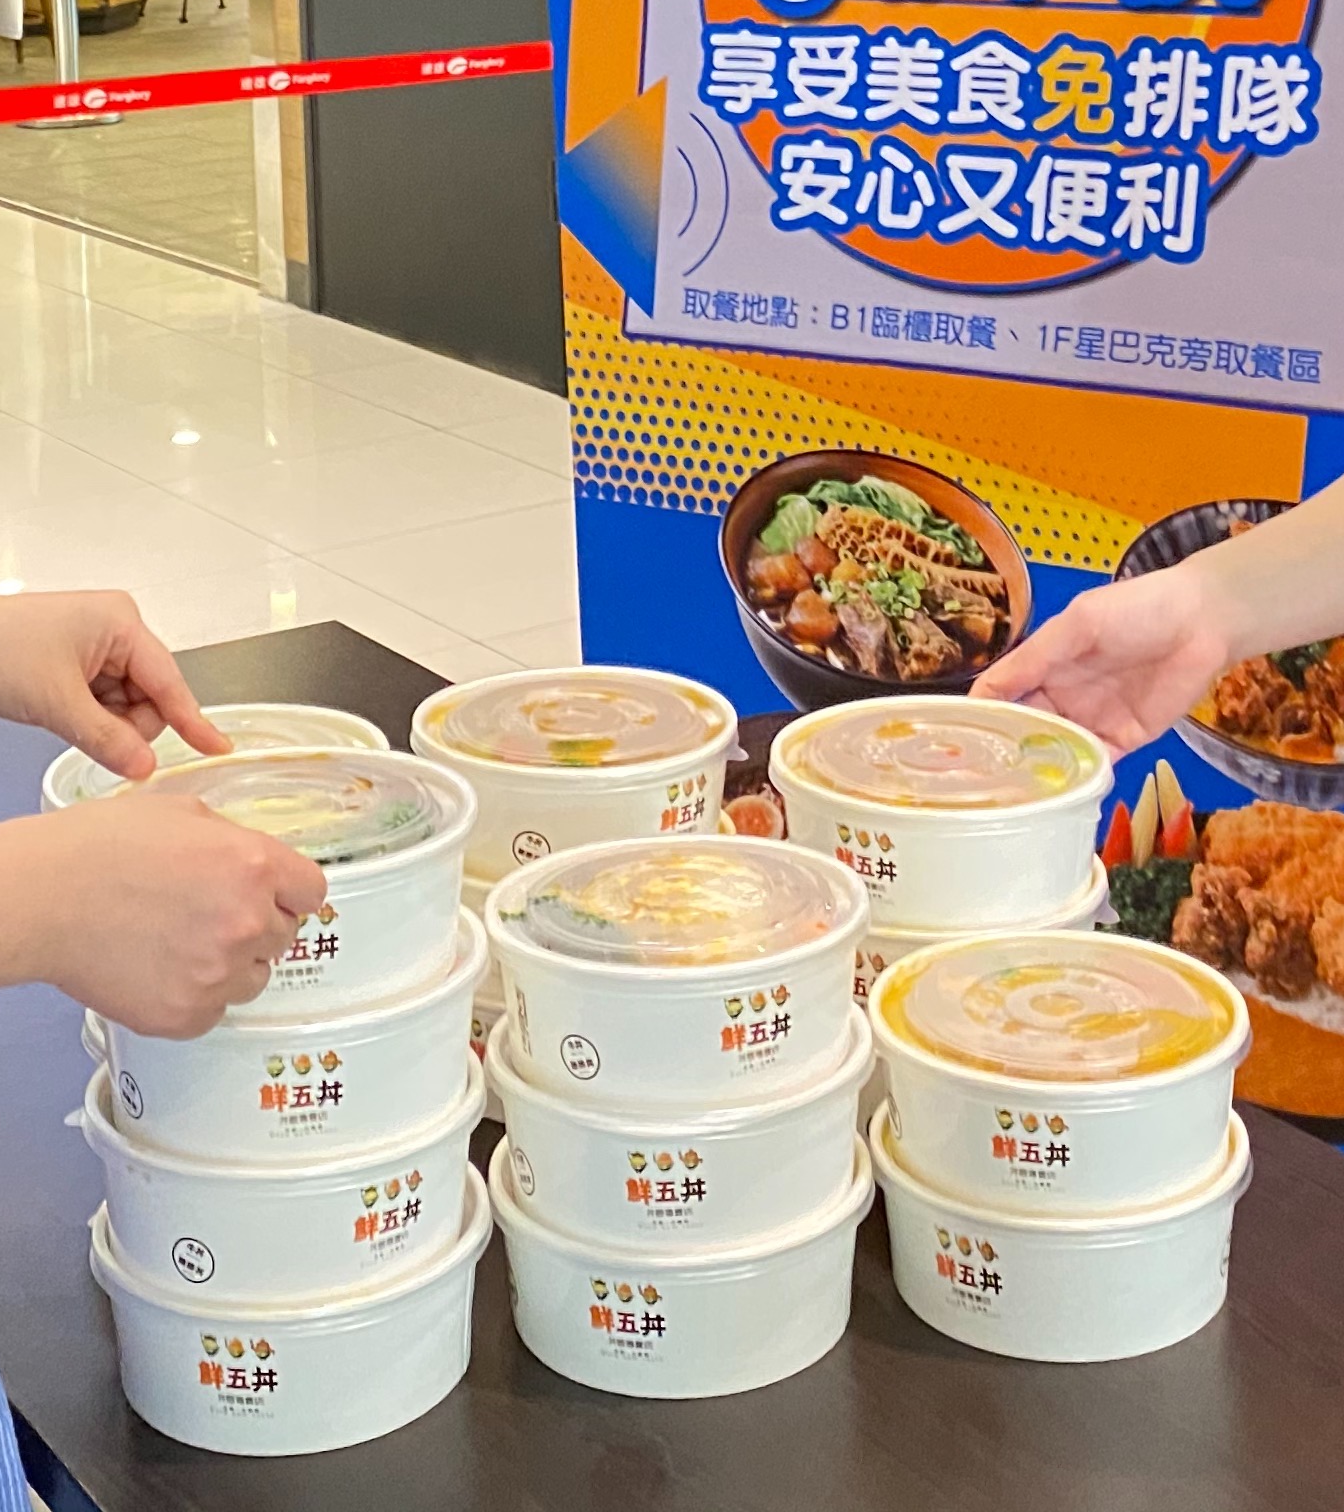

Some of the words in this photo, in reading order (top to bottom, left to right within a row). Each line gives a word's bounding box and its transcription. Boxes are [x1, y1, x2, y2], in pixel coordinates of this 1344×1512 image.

[707, 30, 1311, 146] 享受美食免排隊
[778, 144, 1204, 253] 安心又便利
[275, 933, 339, 966] 五丼
[720, 1012, 792, 1052] 鮮五丼
[259, 1079, 344, 1113] 鮮五丼
[991, 1133, 1071, 1168] 鮮五丼
[625, 1176, 707, 1207] 鮮五丼
[354, 1197, 423, 1243] 鮮五丼
[589, 1303, 666, 1338] 鮮五丼
[198, 1360, 278, 1393] 鮮五丼
